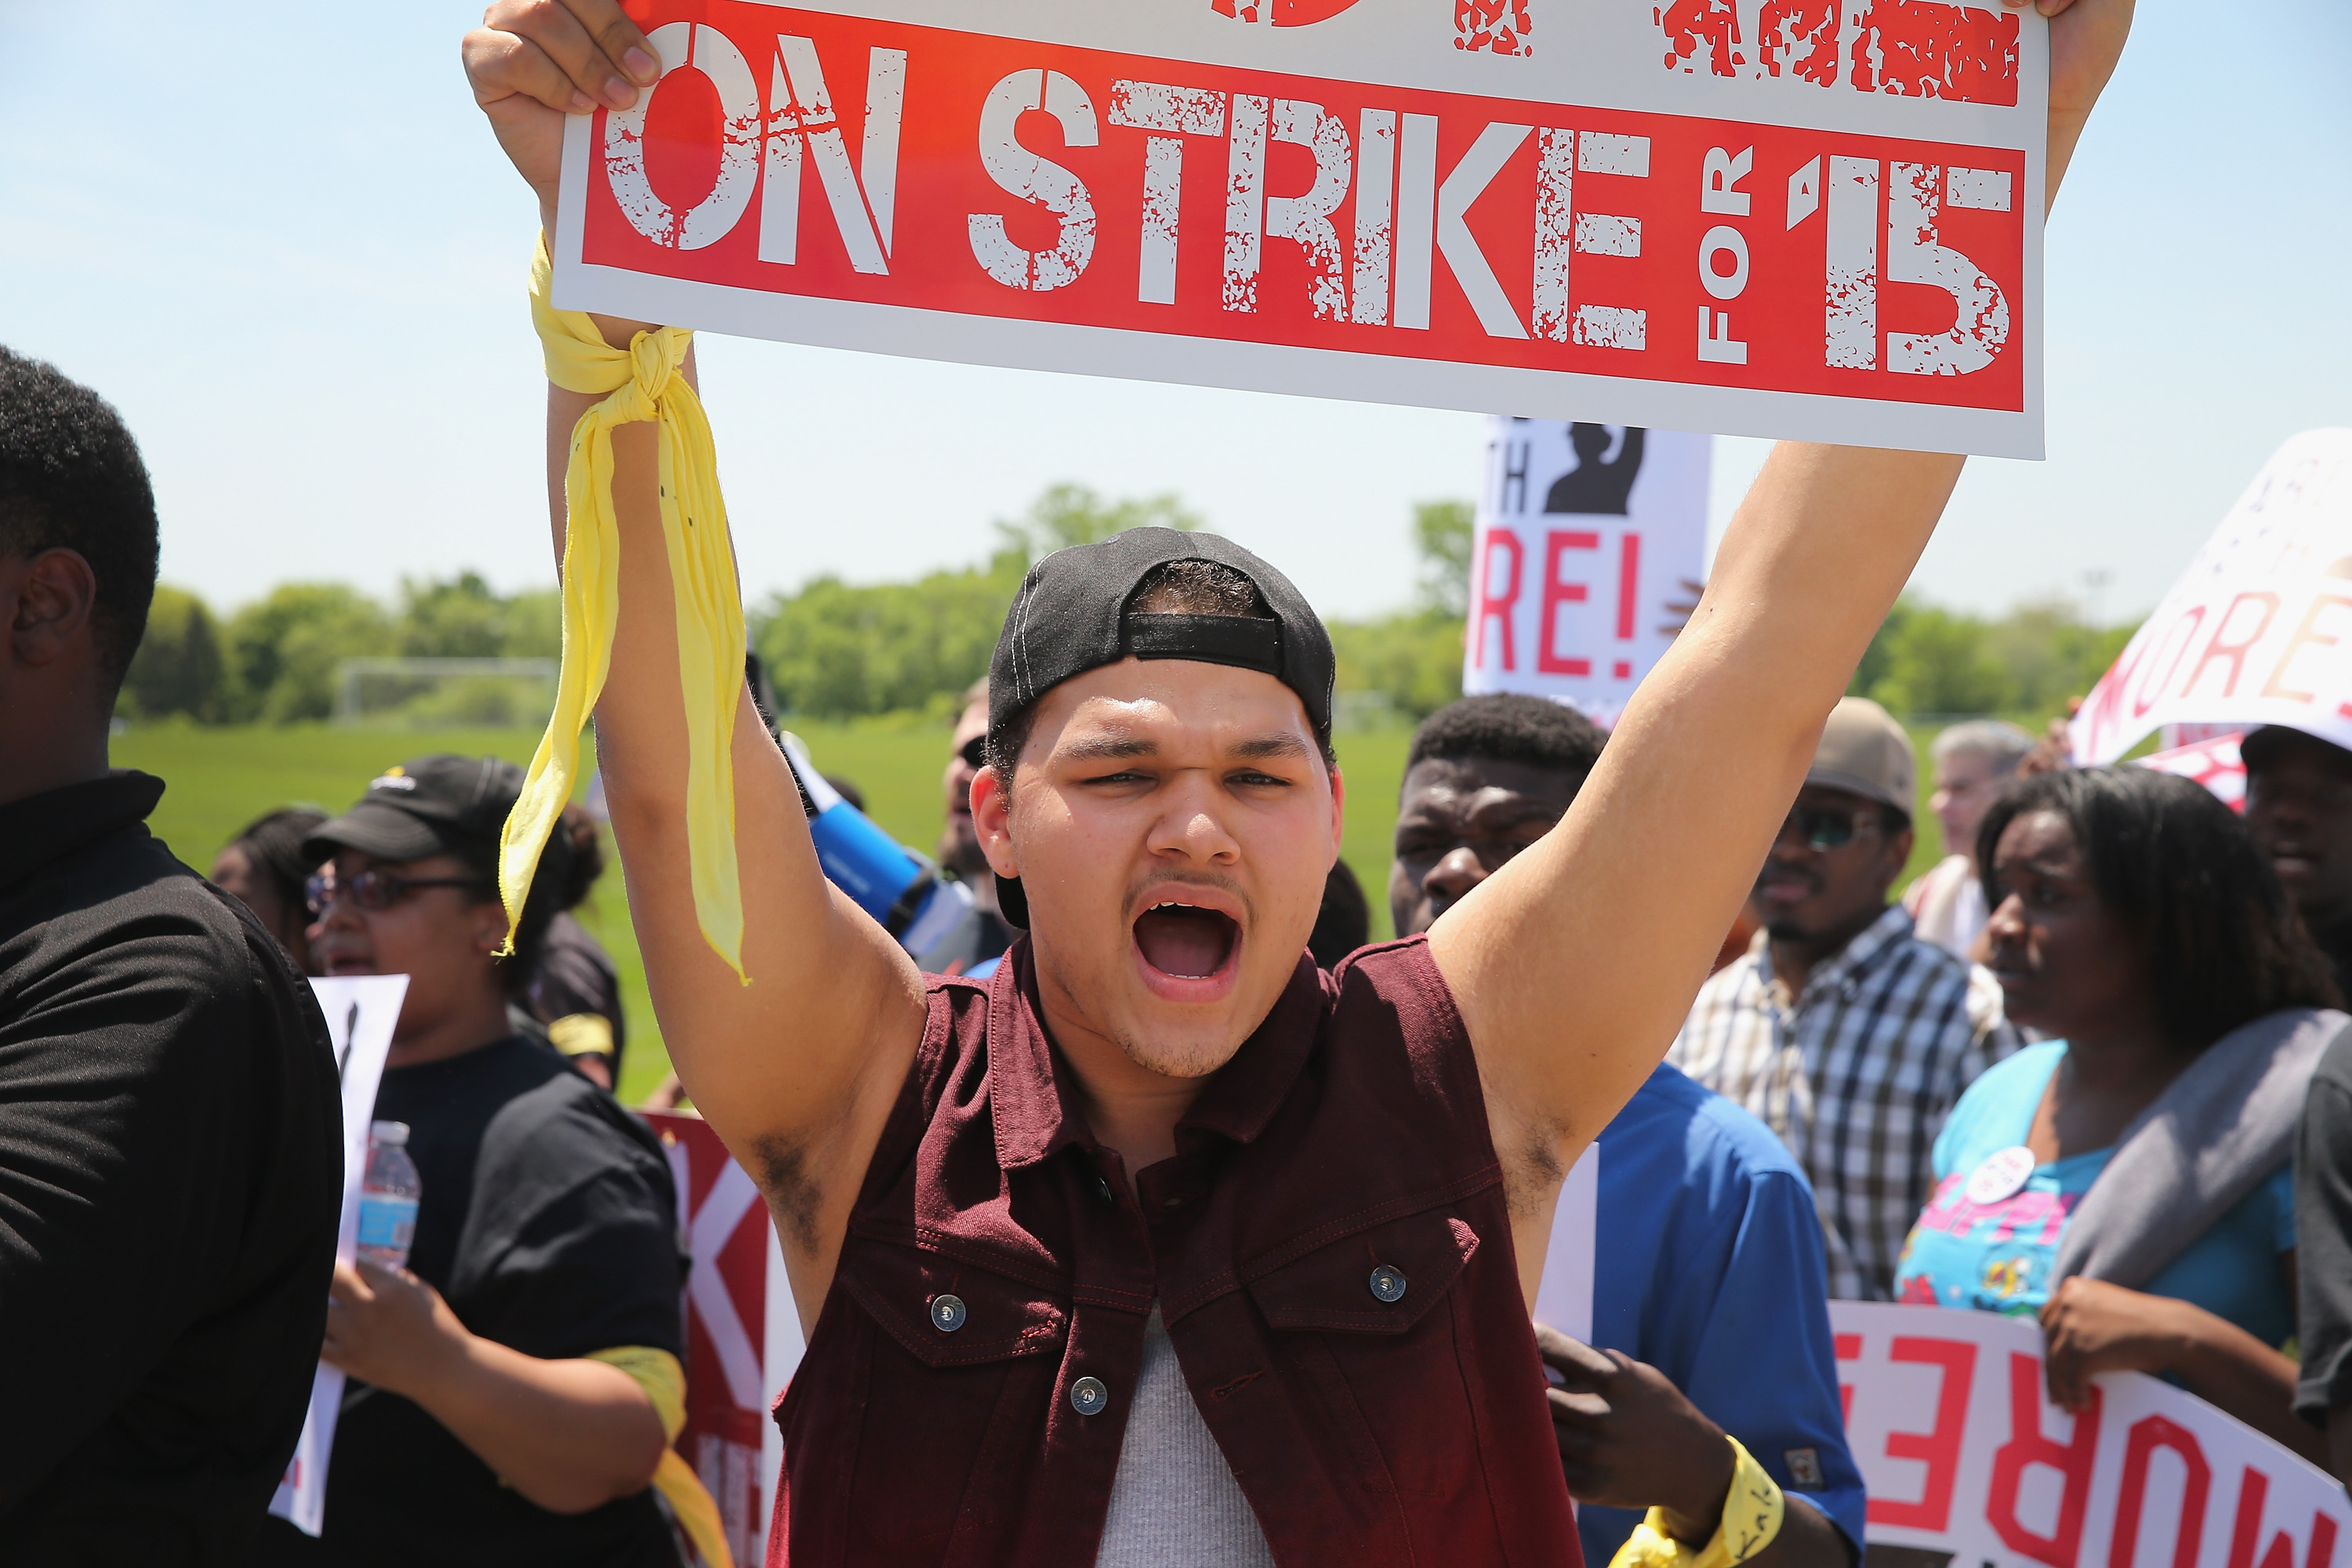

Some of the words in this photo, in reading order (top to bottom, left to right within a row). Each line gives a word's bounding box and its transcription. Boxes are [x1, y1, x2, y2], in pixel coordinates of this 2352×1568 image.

[604, 21, 907, 275] ON
[968, 68, 1651, 351] STRIKE
[1697, 144, 1754, 365] FOR
